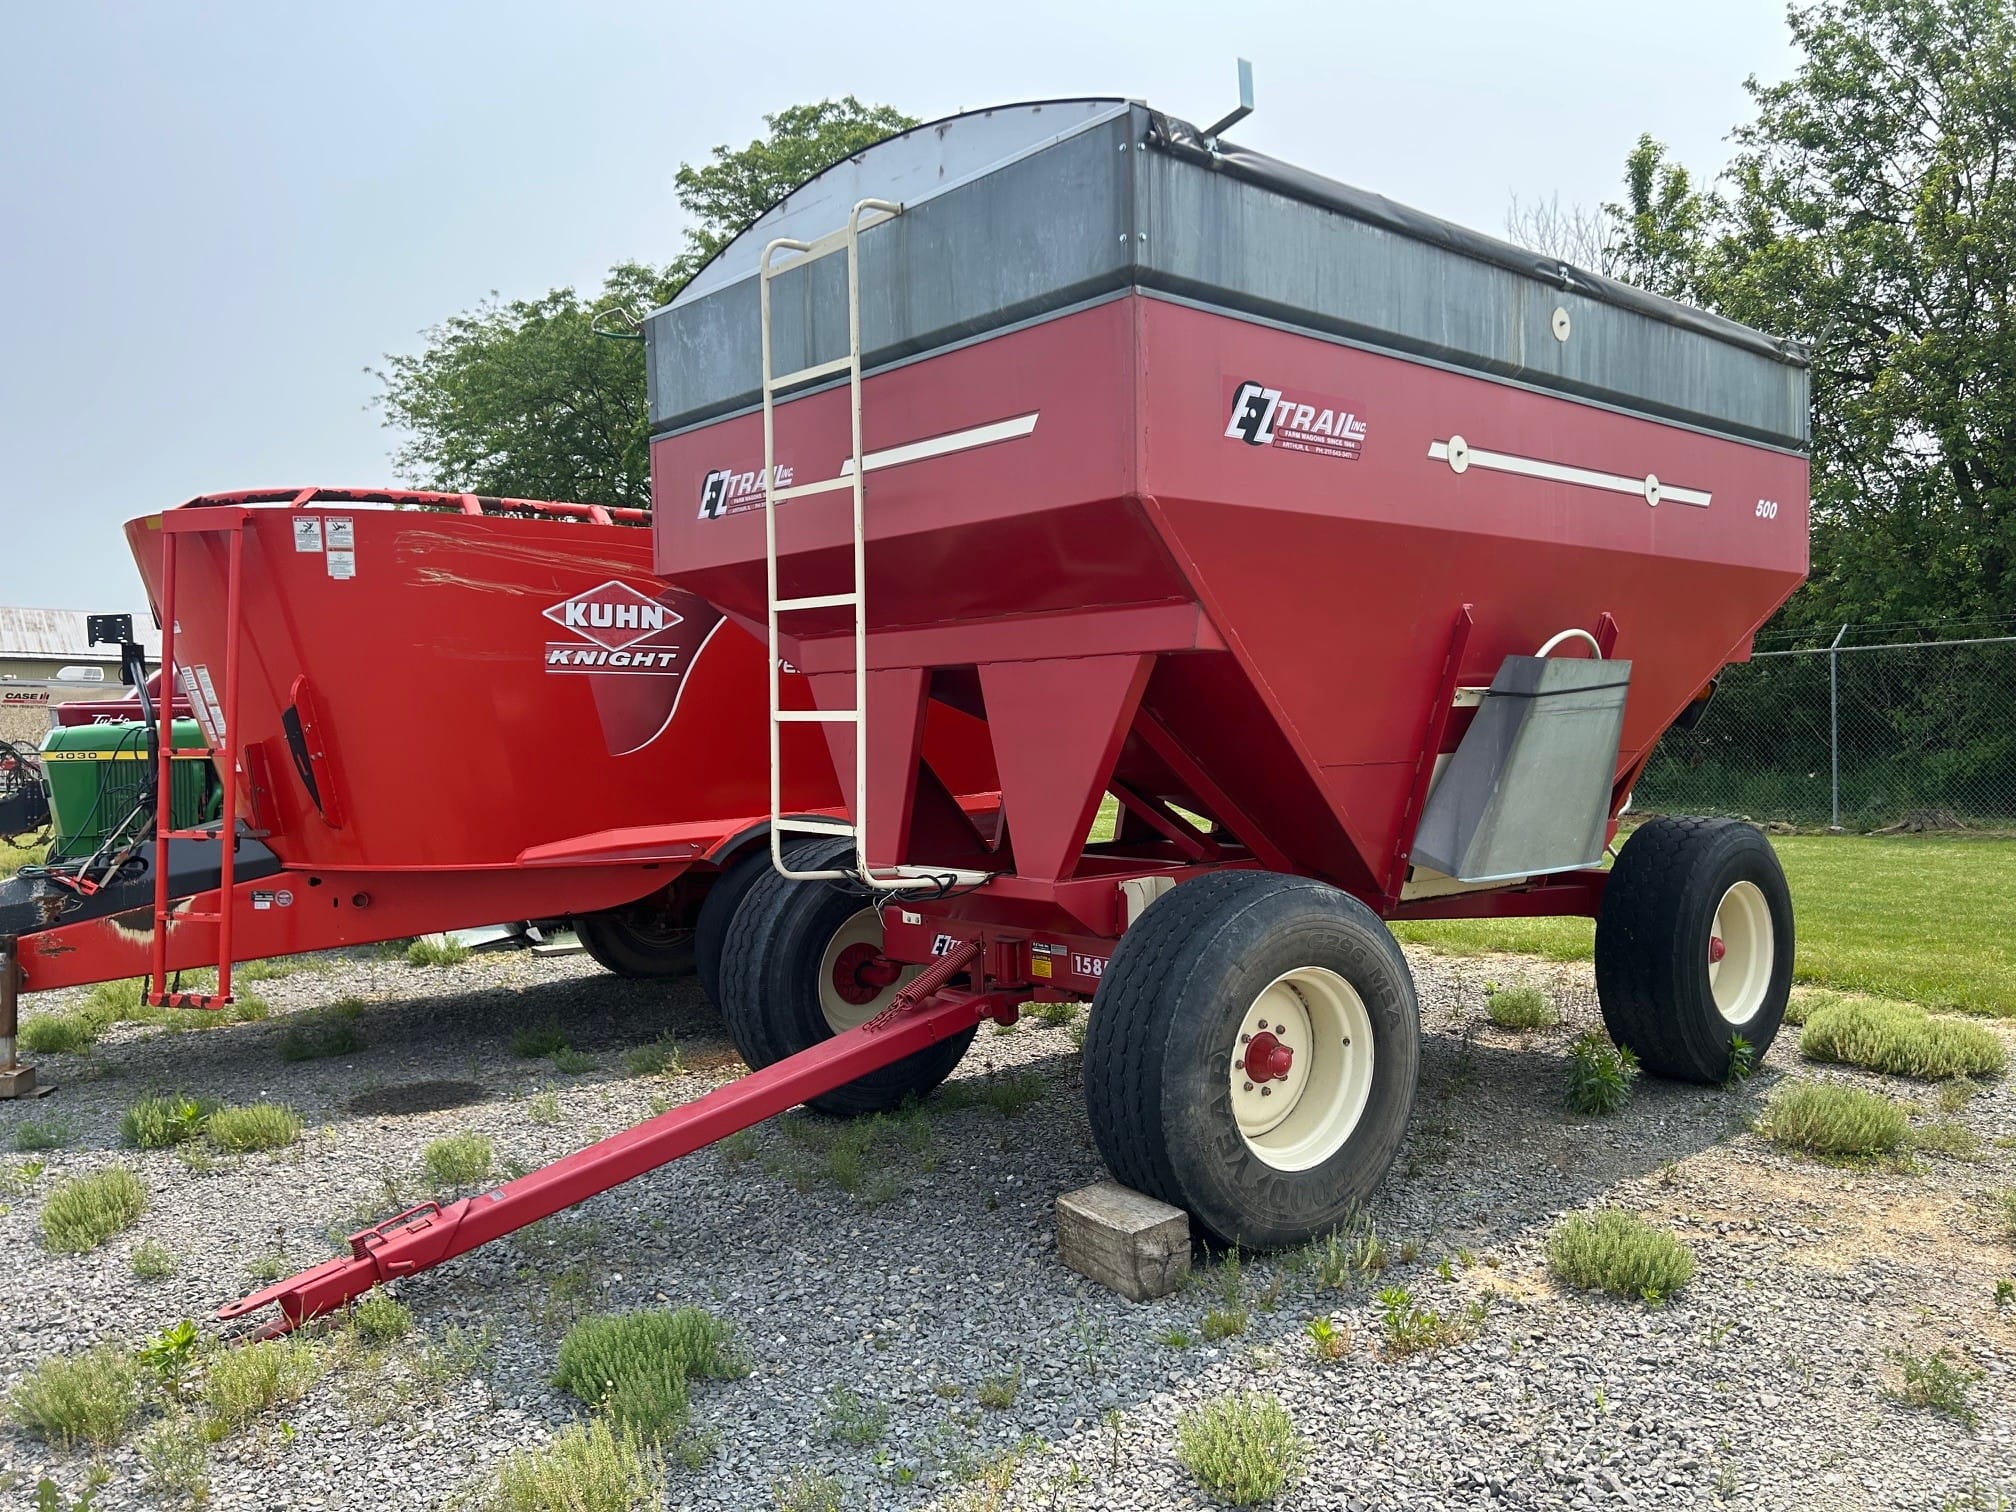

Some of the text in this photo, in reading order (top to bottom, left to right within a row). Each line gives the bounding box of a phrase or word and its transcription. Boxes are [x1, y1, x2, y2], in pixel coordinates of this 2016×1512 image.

[1276, 400, 1366, 441] TRAIL
[1284, 430, 1301, 439] FARM
[1301, 433, 1326, 443] WAGONS
[1326, 437, 1343, 446] SINCE
[1755, 499, 1778, 519] 500
[565, 602, 664, 630] KUHN
[547, 650, 678, 668] KNIGHT
[5, 692, 38, 700] CASE
[56, 752, 98, 760] 4030
[1305, 931, 1368, 965] G296
[1075, 956, 1109, 976] 158
